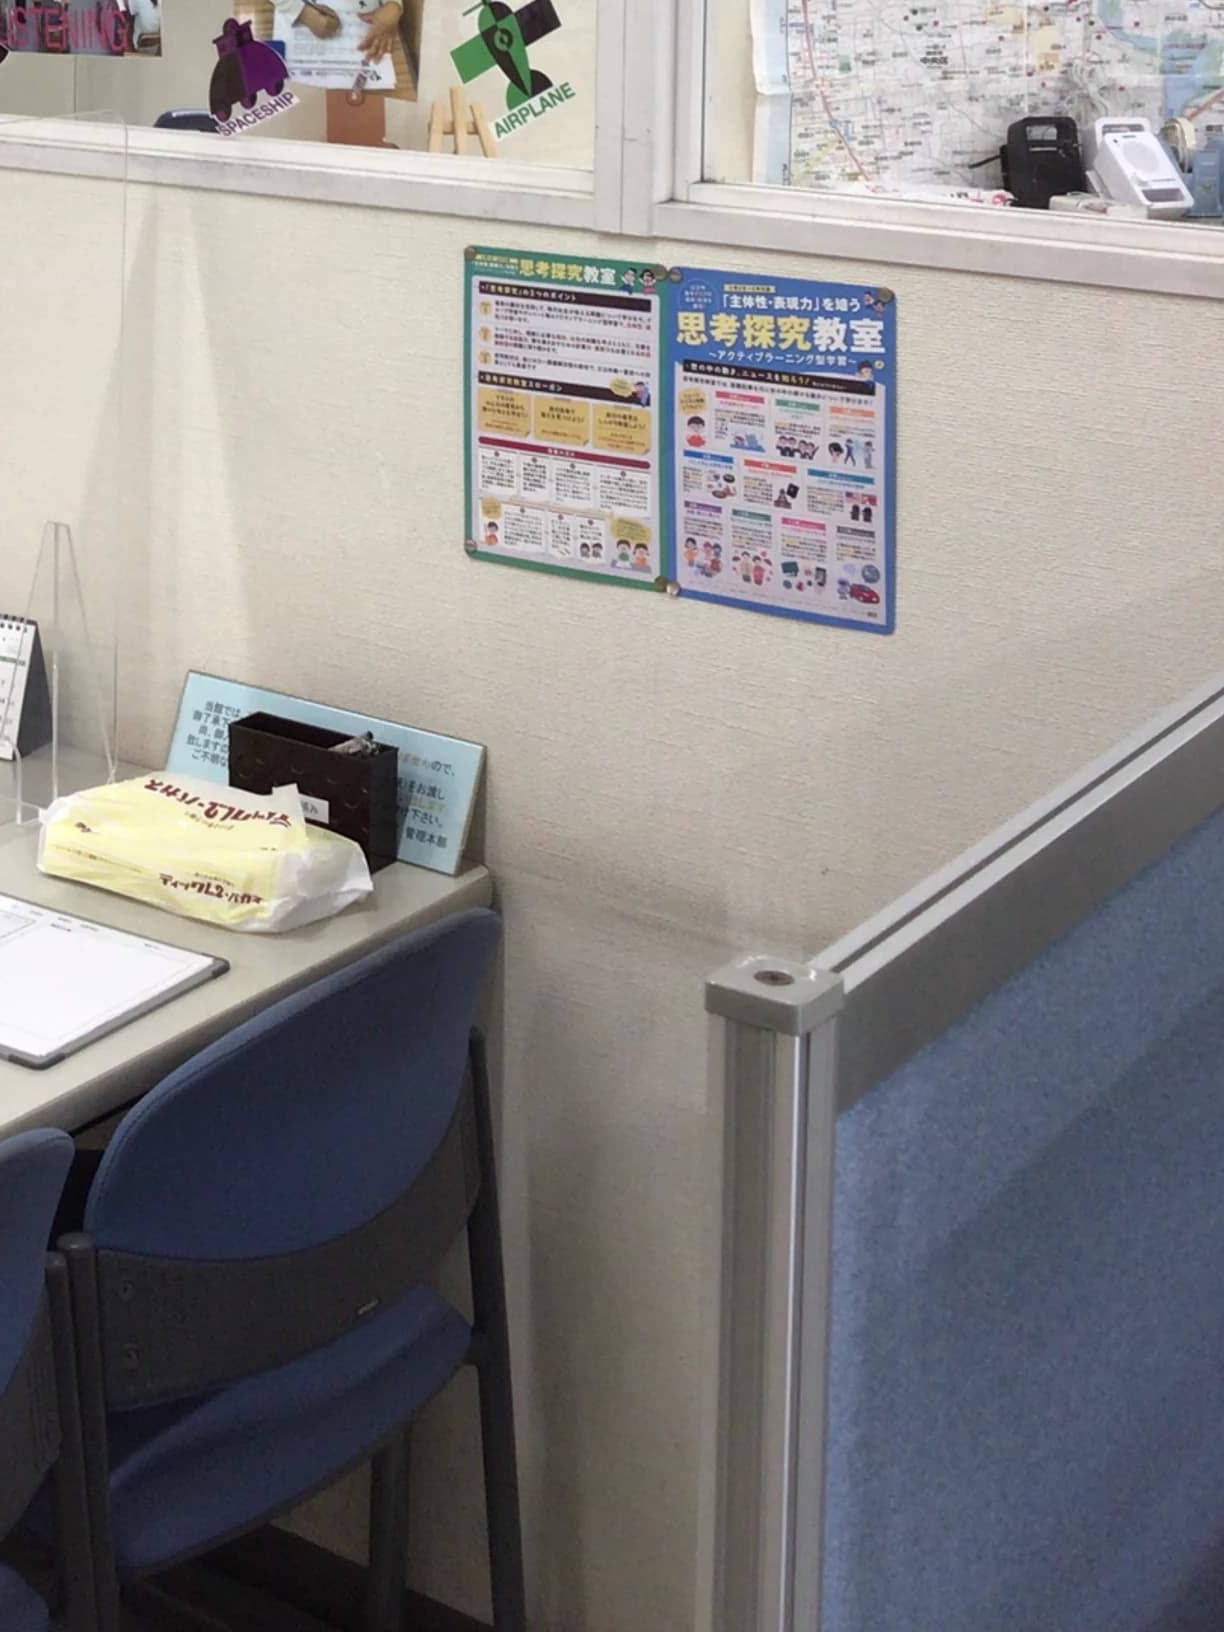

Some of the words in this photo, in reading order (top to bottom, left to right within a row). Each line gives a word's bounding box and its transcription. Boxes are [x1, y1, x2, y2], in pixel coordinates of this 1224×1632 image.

[219, 92, 295, 136] SPACESHIP
[493, 82, 577, 139] AIRPLANE
[520, 259, 616, 286] 思考探究教室
[676, 312, 886, 354] 思考探究教室
